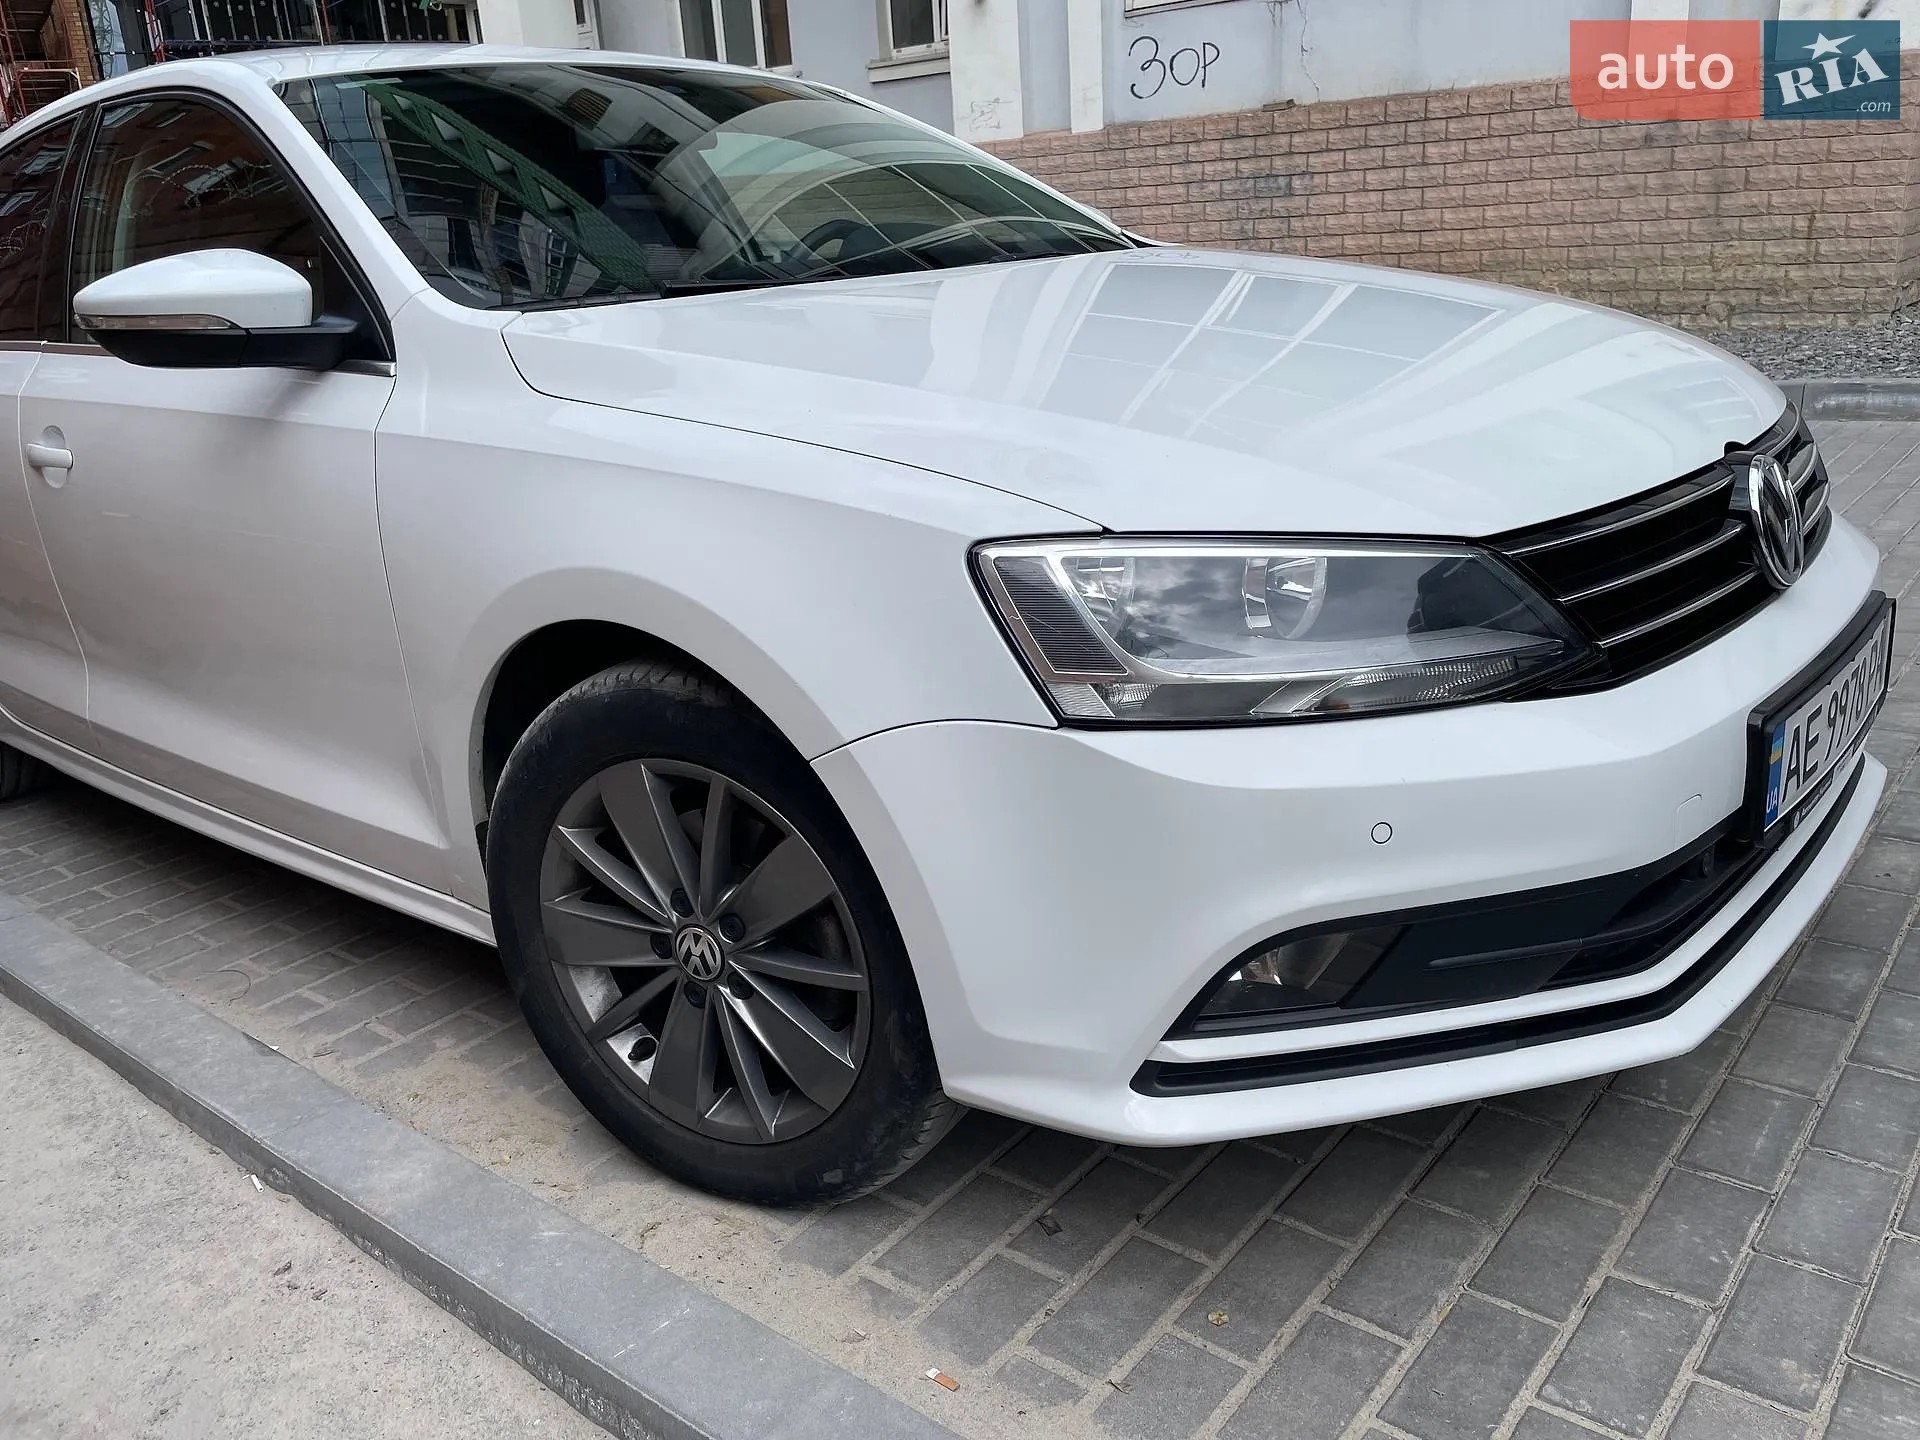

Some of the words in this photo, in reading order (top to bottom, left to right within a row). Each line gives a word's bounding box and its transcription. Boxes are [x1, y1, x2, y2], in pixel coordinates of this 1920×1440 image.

[1782, 703, 1823, 804] AE
[1824, 656, 1867, 762] 9978
[1766, 786, 1778, 814] UA
